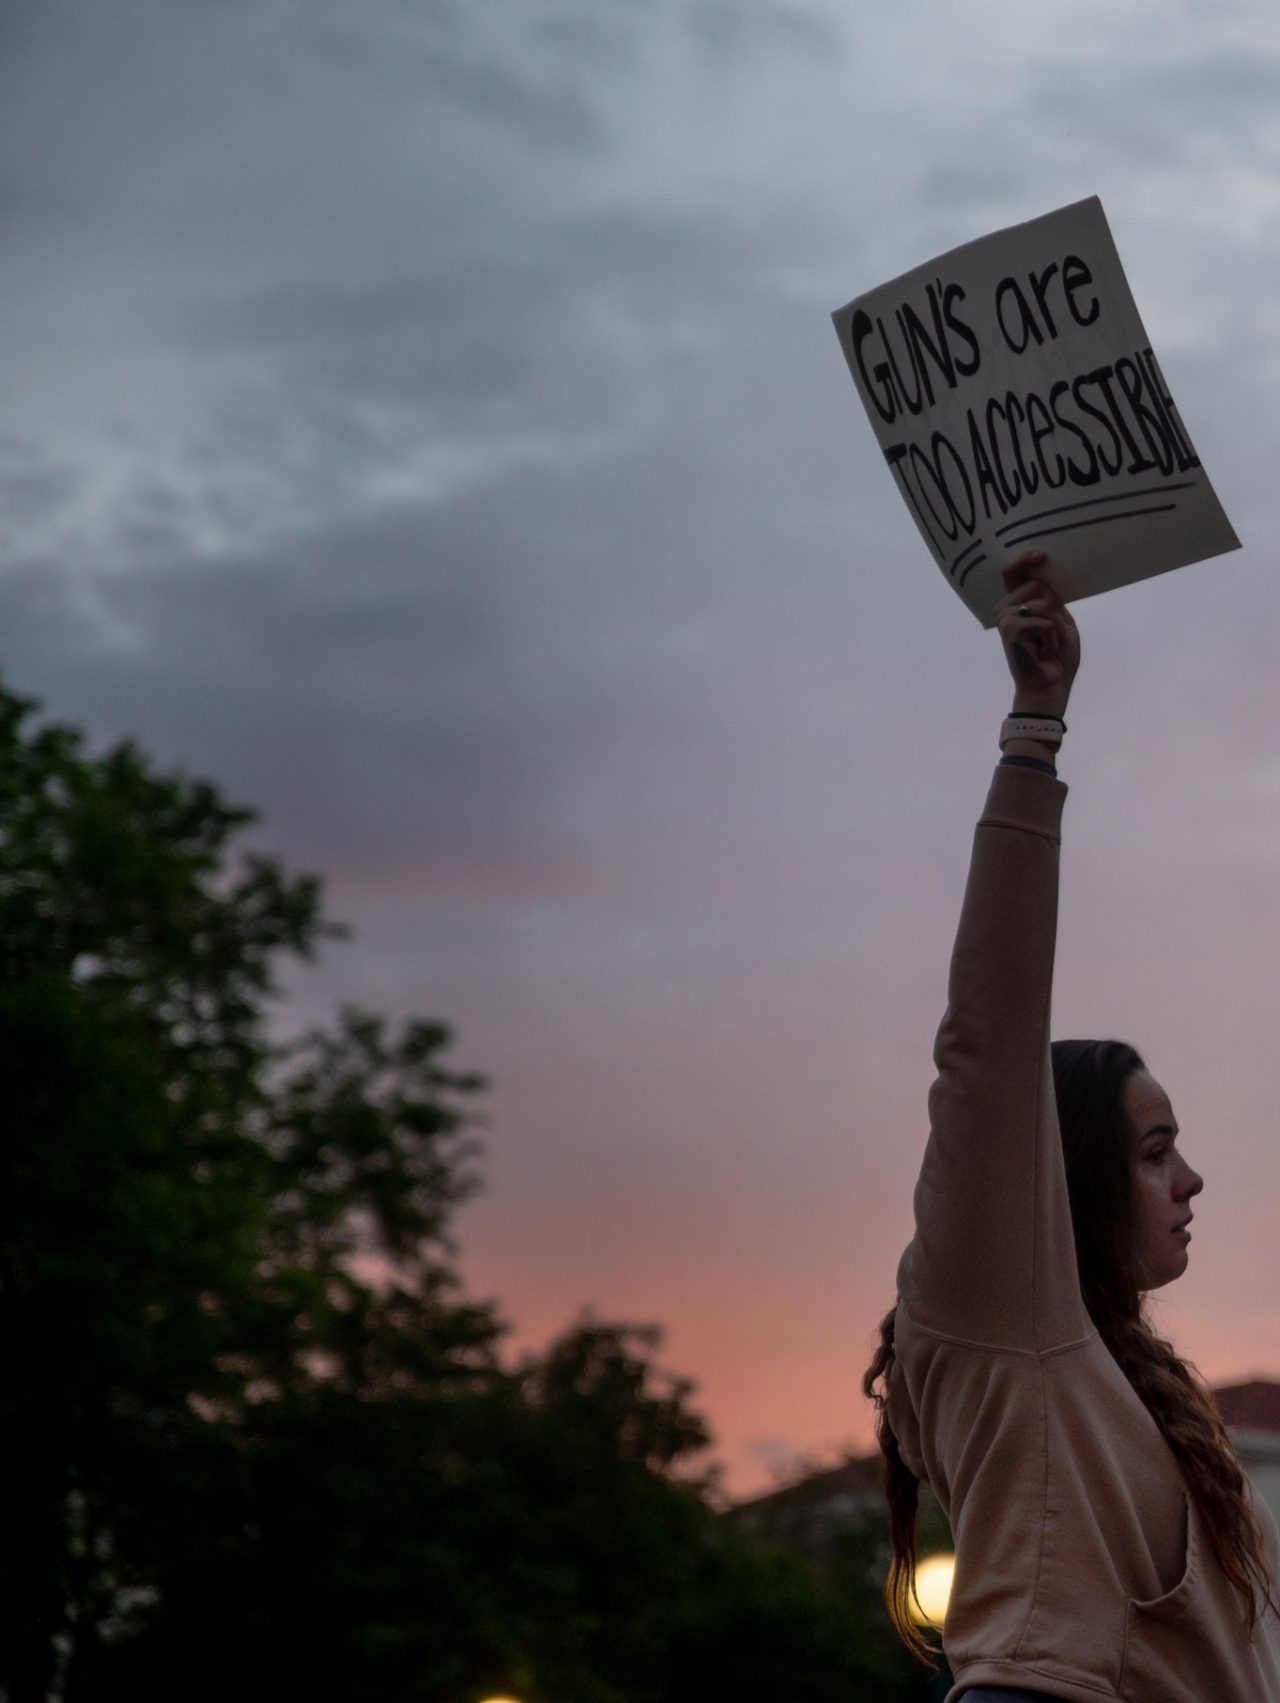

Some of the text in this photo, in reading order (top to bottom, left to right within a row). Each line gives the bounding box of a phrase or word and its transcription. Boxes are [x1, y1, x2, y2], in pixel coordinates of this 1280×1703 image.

[851, 255, 1100, 424] GUN'S are
[883, 431, 976, 561] TOO
